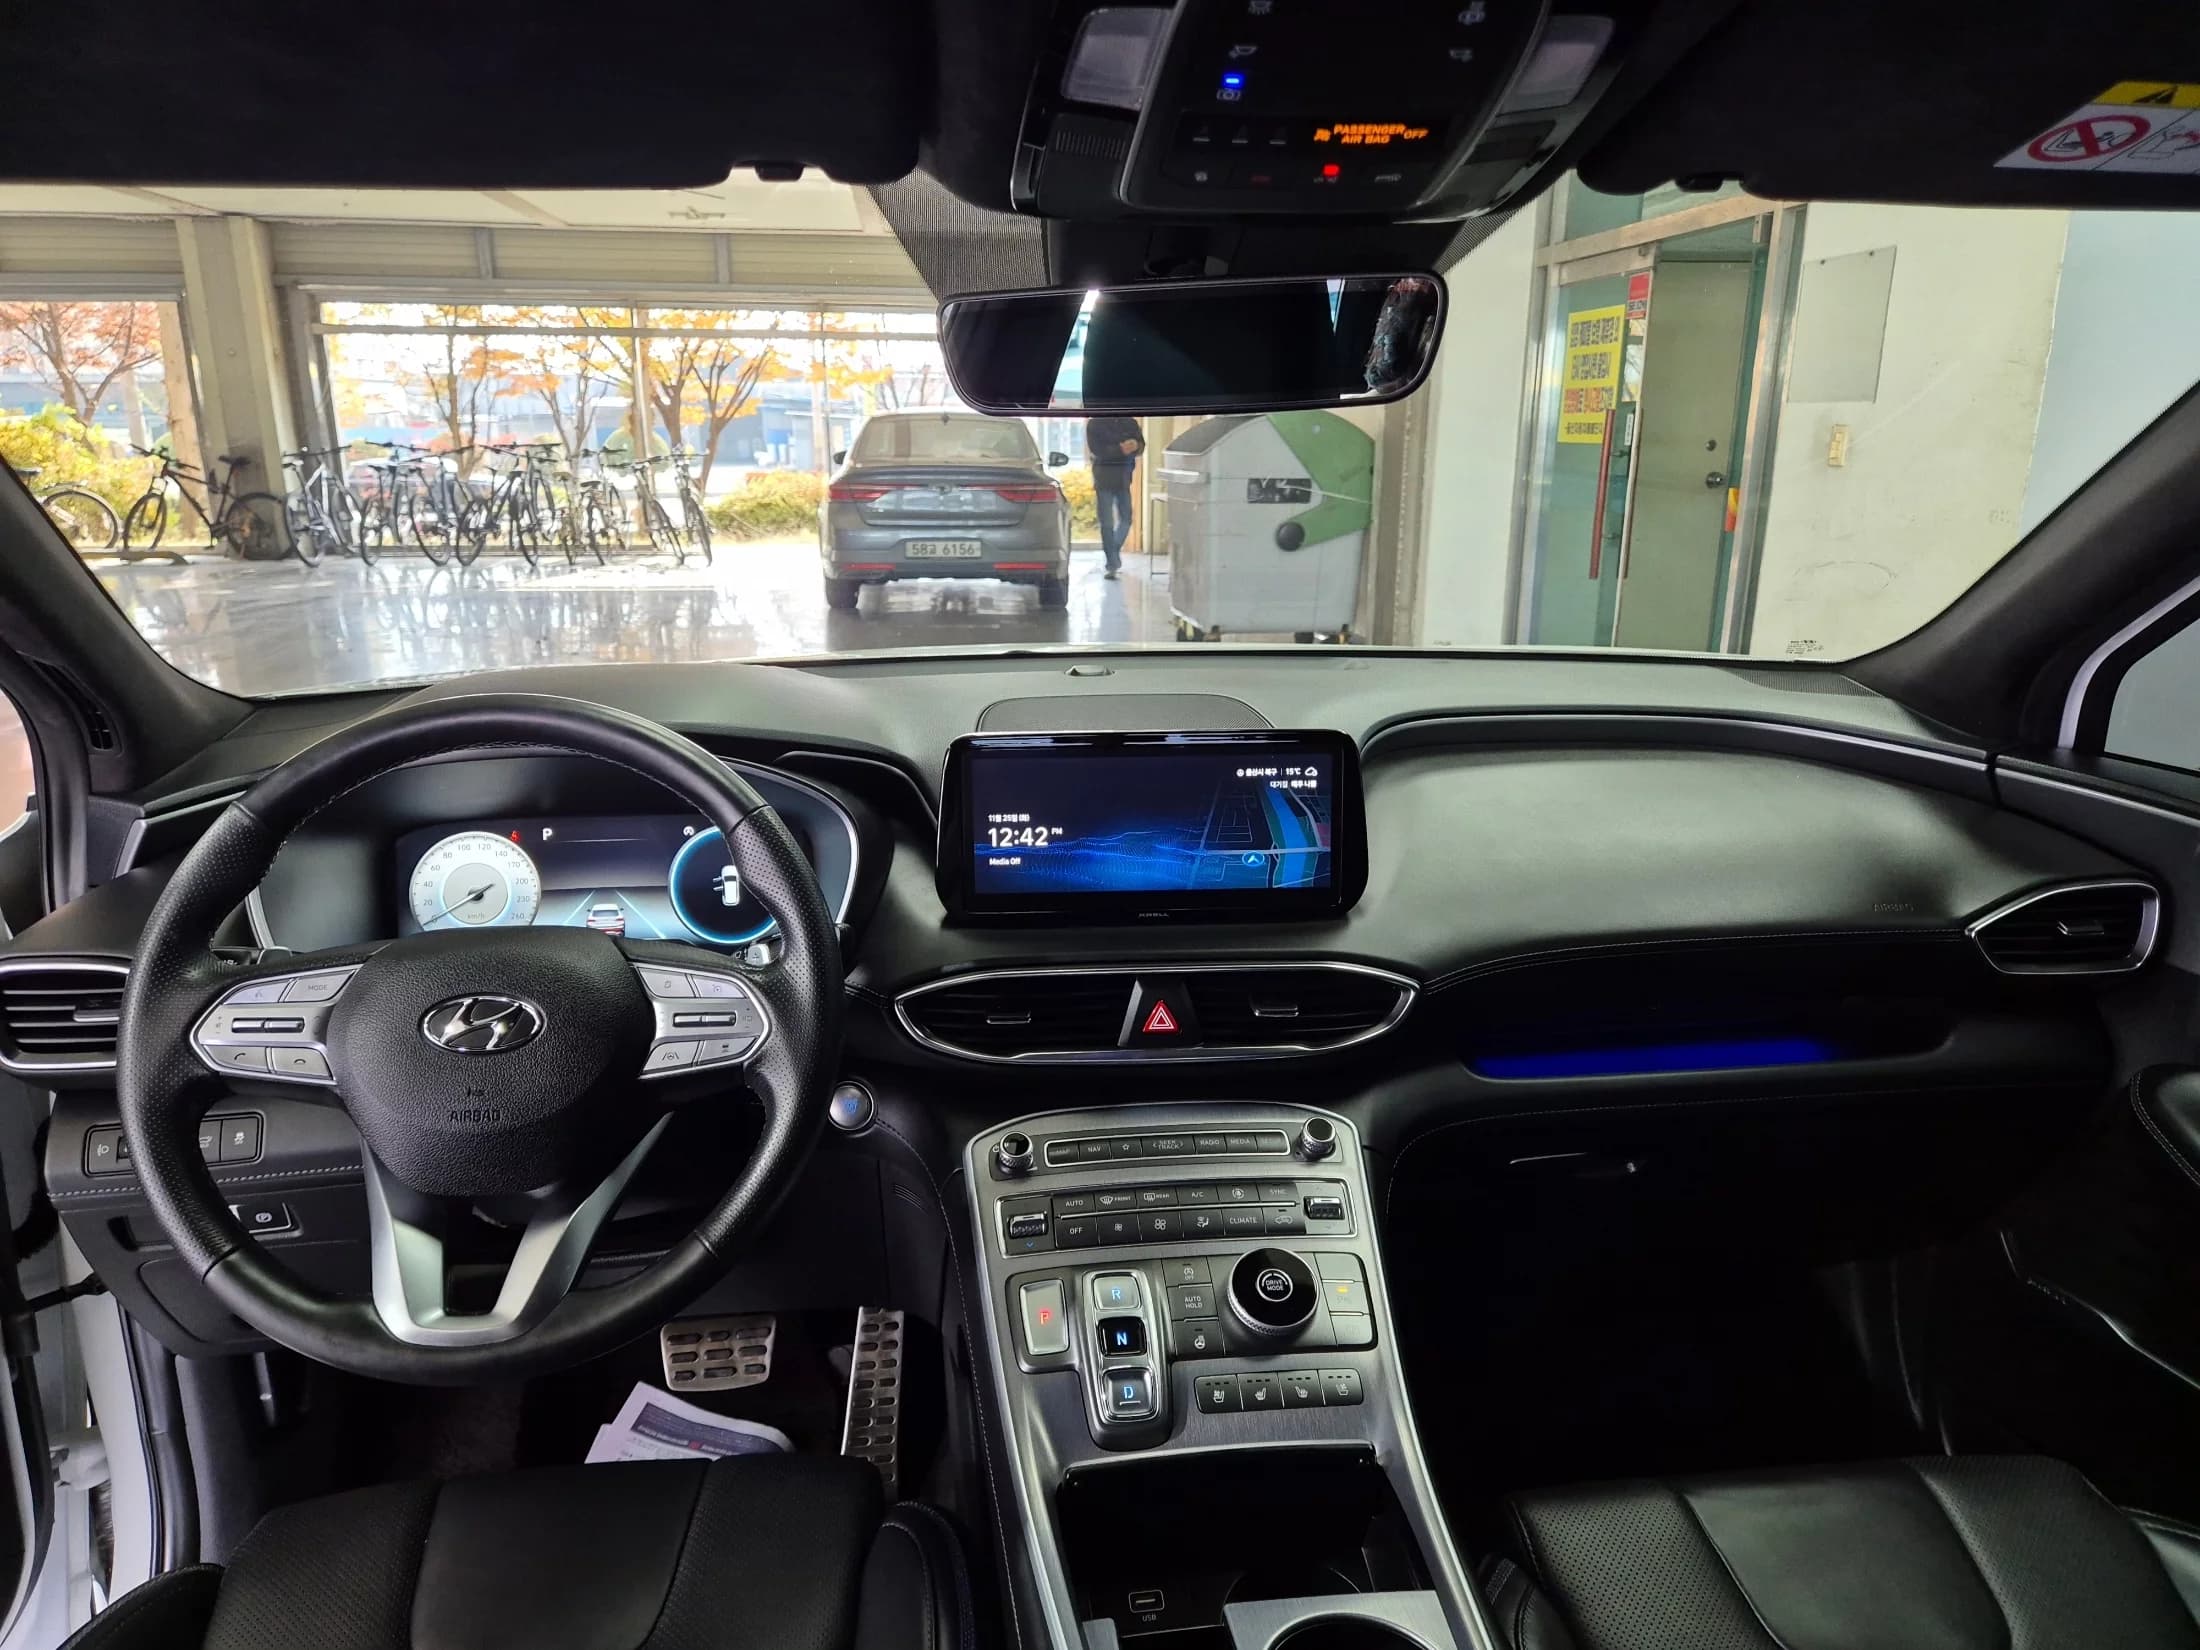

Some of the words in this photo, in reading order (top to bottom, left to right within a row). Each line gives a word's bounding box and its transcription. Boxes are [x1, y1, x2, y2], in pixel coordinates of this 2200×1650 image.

[1334, 123, 1406, 134] PASSENGER
[1341, 135, 1362, 144] AIR
[1365, 134, 1390, 144] BAG
[1403, 129, 1428, 139] OFF
[942, 543, 975, 556] 6156
[542, 828, 553, 841] P
[987, 826, 1049, 848] 12:42
[1087, 1145, 1101, 1153] NAV
[1191, 1191, 1205, 1199] A/C
[1065, 1199, 1084, 1207] AUTO
[1229, 1216, 1257, 1225] CLIMATE
[1069, 1226, 1083, 1235] OFF
[1111, 1289, 1121, 1300] R
[1040, 1312, 1049, 1325] P
[1116, 1332, 1128, 1346] N
[1123, 1386, 1134, 1399] D
[1142, 1614, 1157, 1622] USB
